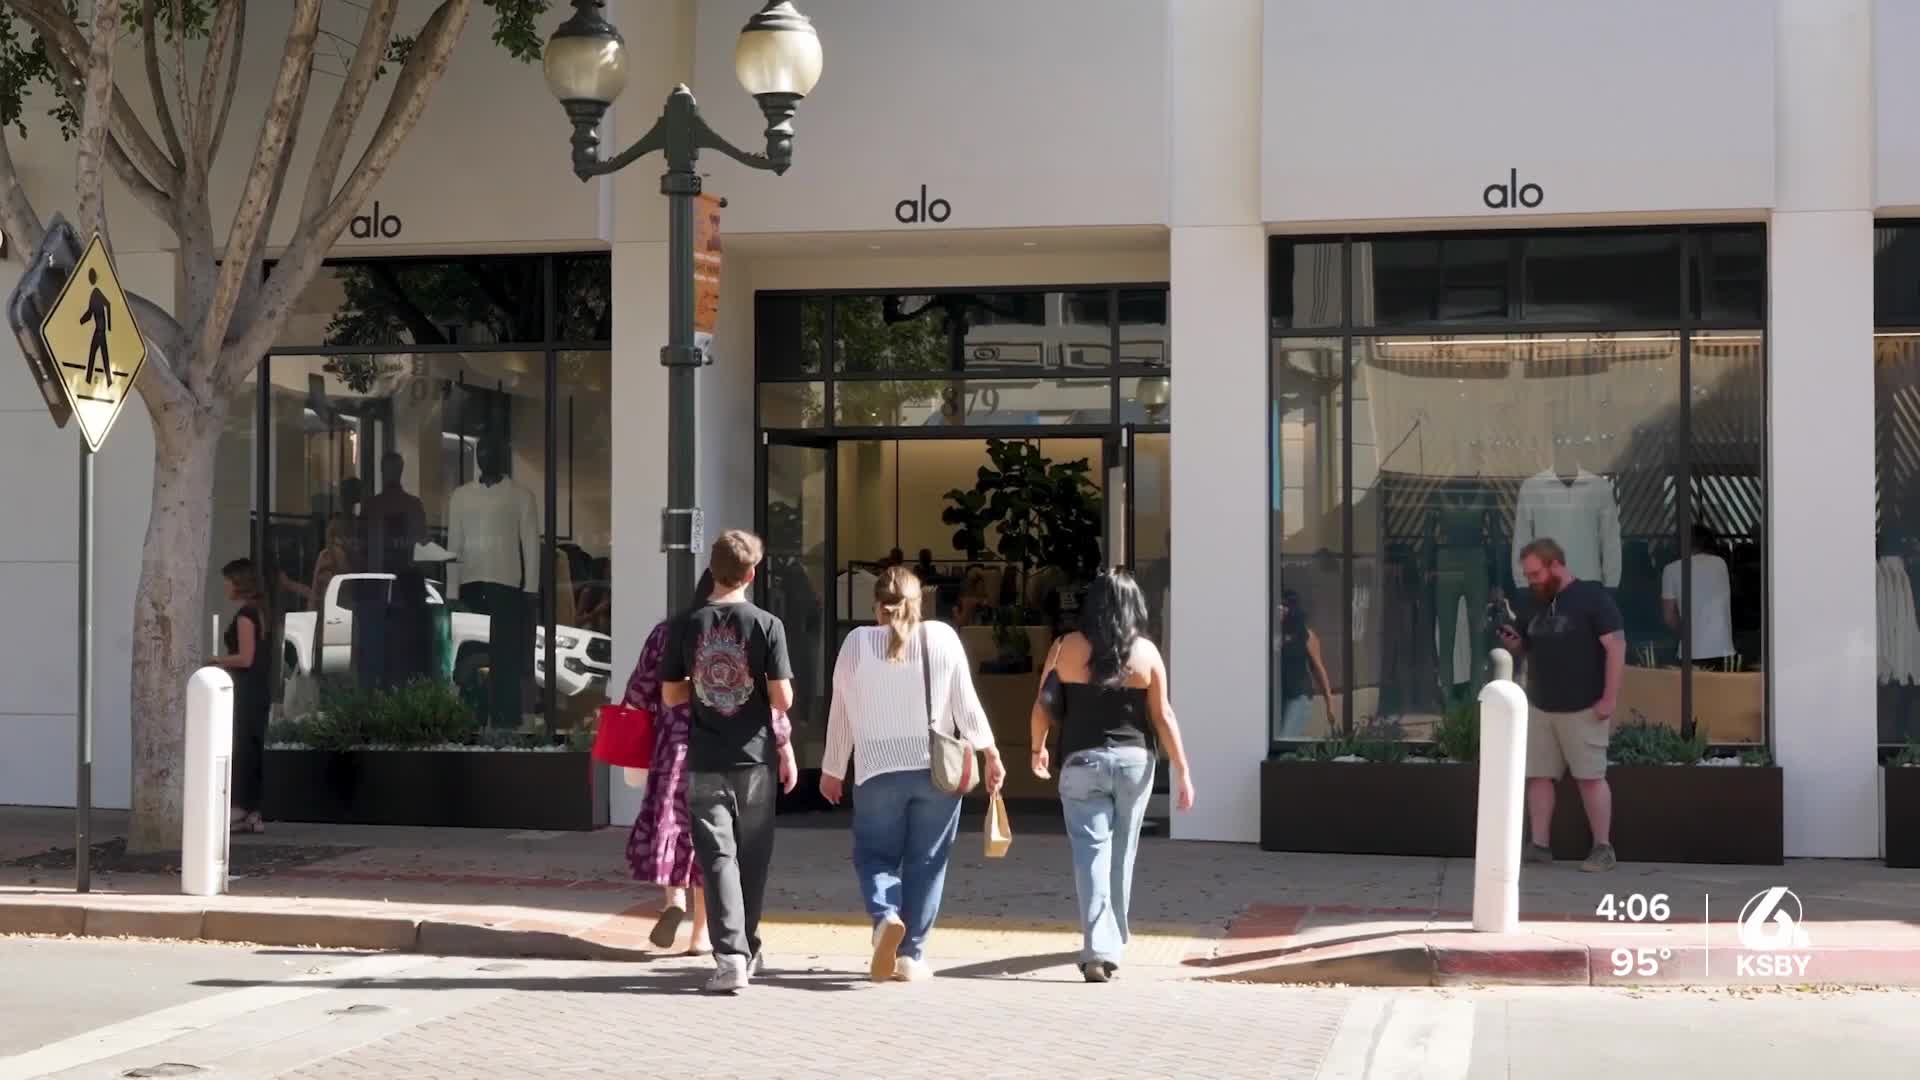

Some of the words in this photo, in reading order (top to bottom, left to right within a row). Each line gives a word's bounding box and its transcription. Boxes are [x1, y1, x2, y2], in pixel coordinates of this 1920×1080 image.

[895, 184, 952, 223] alo
[1483, 167, 1544, 208] alo
[350, 200, 402, 239] alo
[941, 385, 1001, 417] 879
